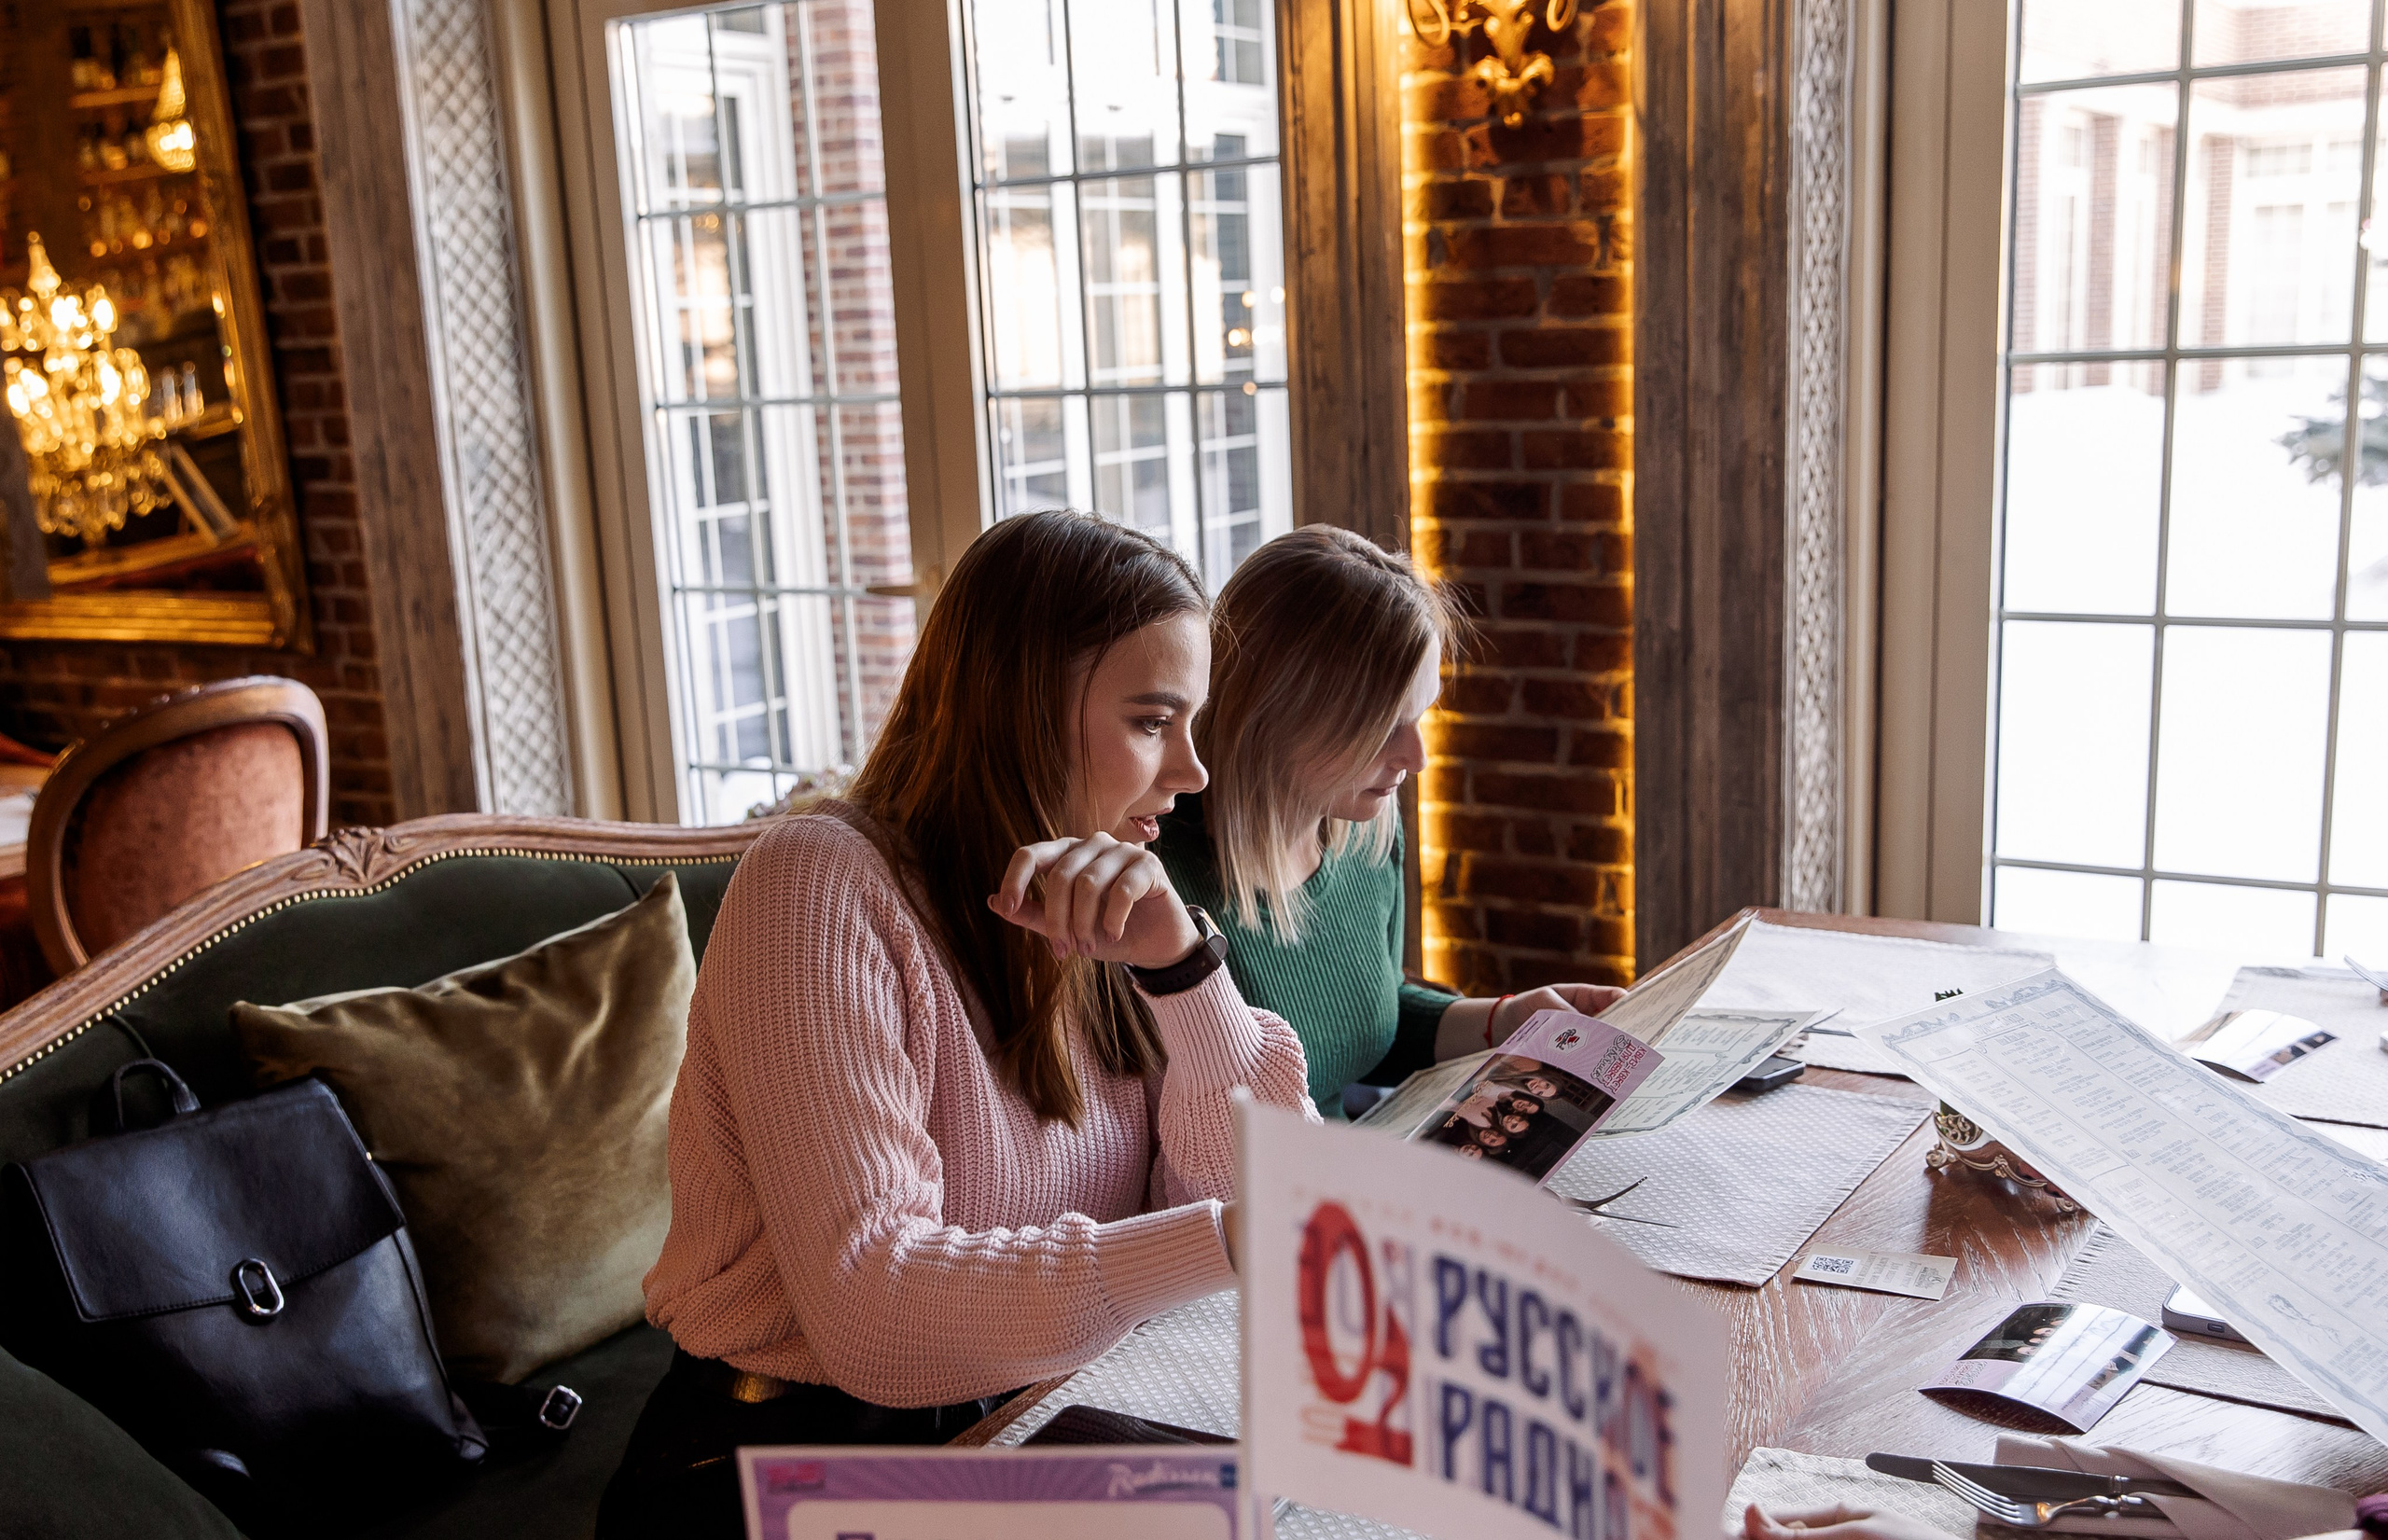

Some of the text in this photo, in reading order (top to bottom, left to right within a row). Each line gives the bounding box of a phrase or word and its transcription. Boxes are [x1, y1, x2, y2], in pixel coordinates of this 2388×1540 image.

[1601, 1042, 1636, 1086] ДЛЯ НЕВЕСТ
[1608, 1046, 1647, 1093] КВИЗ-КВЕСТ
